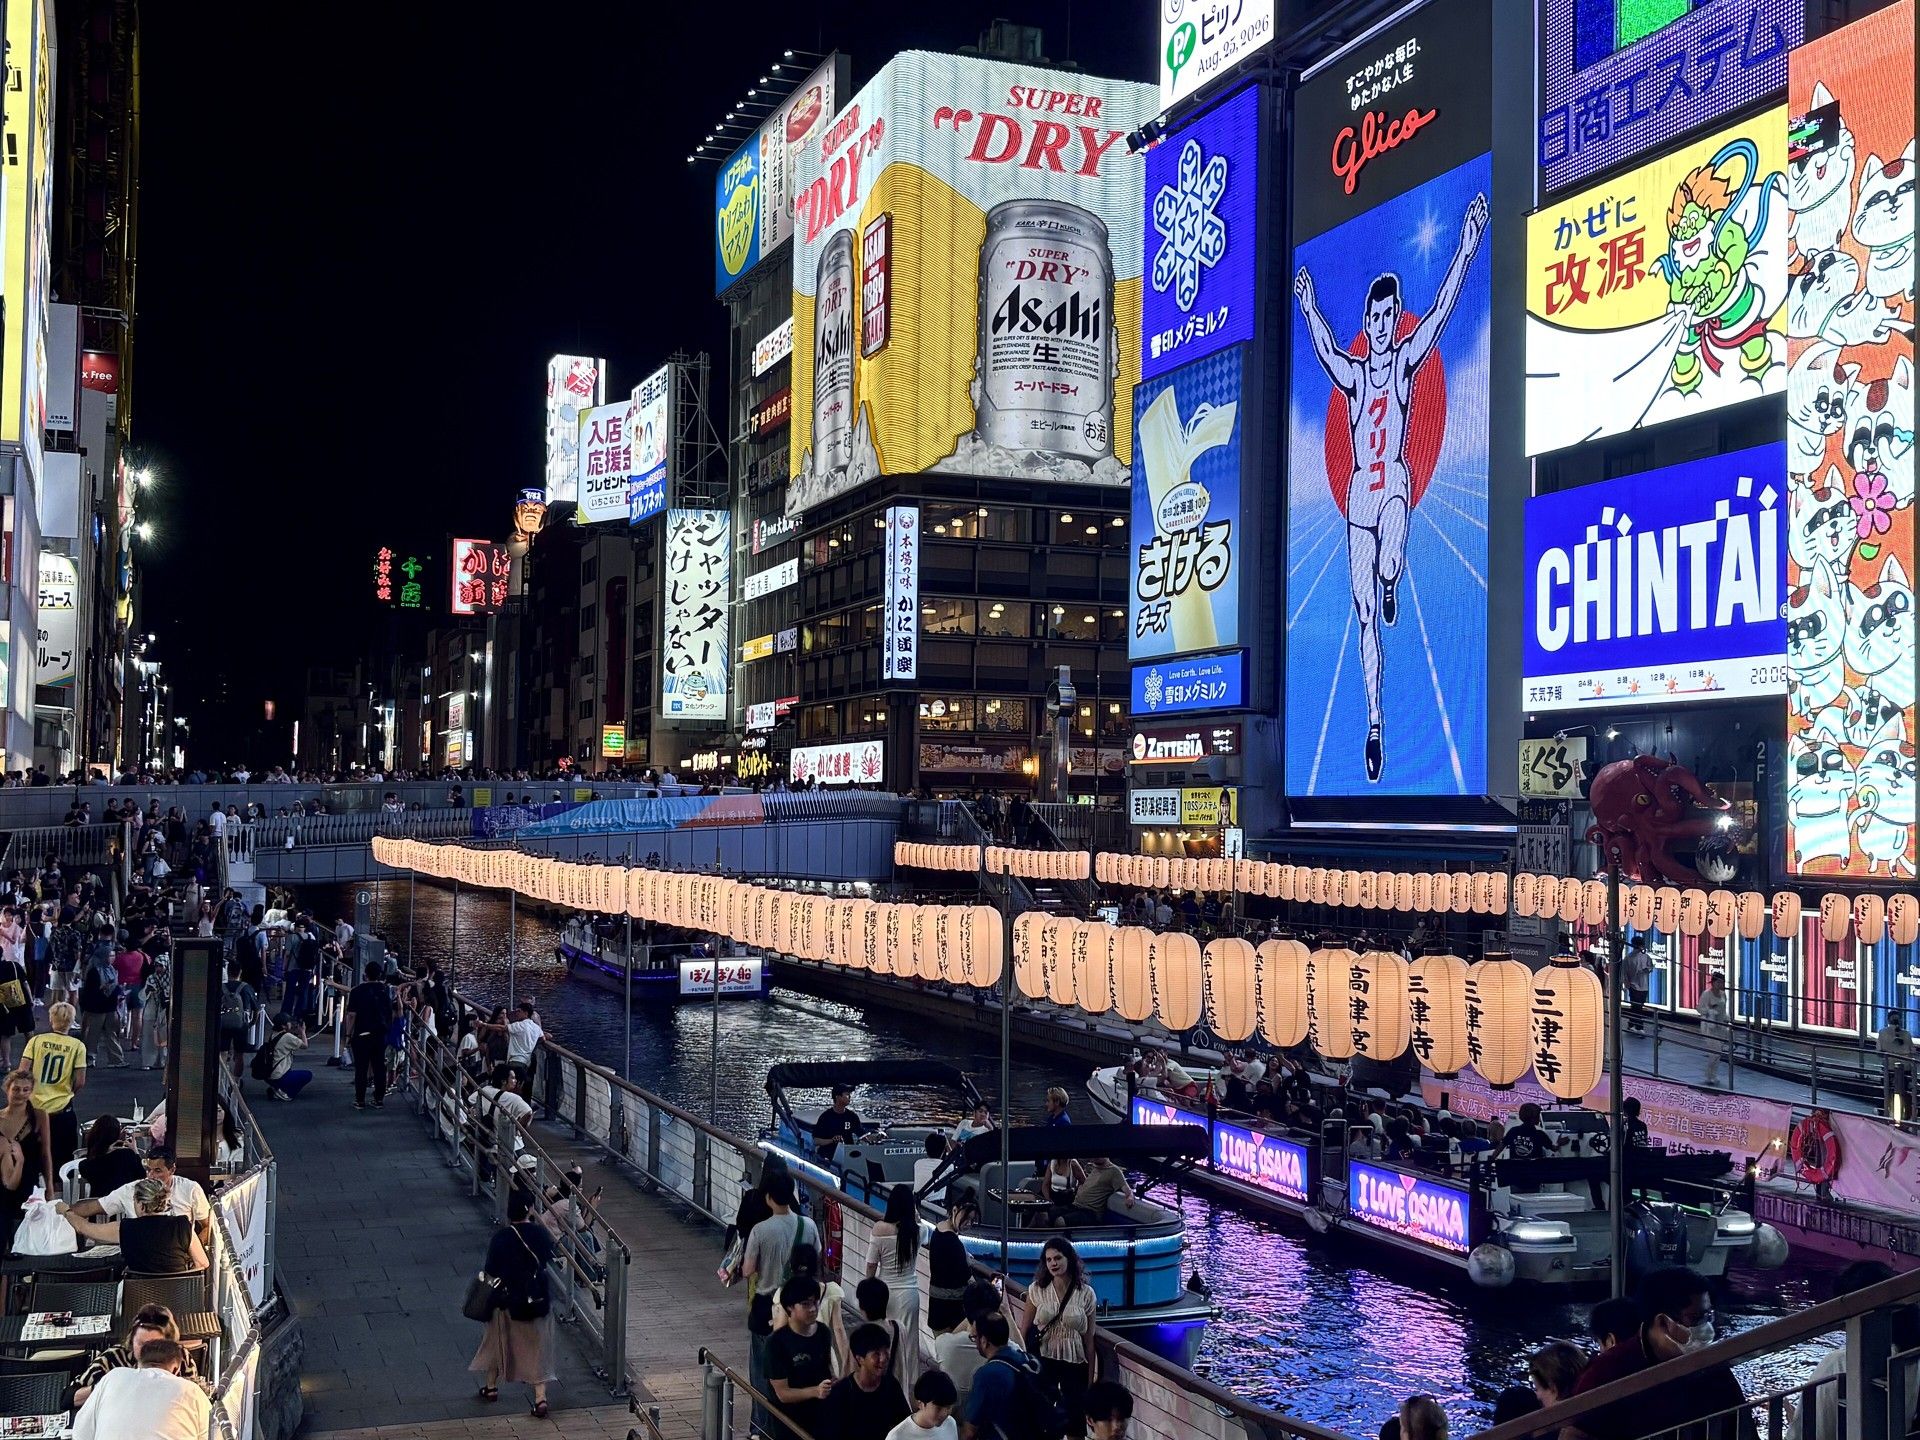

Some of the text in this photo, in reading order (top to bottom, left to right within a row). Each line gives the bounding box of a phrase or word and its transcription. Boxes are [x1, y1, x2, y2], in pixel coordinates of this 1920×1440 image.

[1197, 51, 1222, 77] Aug.
[1239, 14, 1269, 51] 2026
[1345, 37, 1421, 94] すこやかな毎日、
[1006, 84, 1103, 119] SUPER
[1350, 62, 1414, 111] ゆたかな人生
[1331, 108, 1437, 195] Glico
[864, 225, 886, 268] ASAHI
[1553, 194, 1637, 253] かぜに
[1028, 248, 1070, 262] SUPER
[1543, 224, 1647, 316] 改源
[863, 272, 885, 315] 1889
[991, 283, 1100, 344] Asahi
[863, 310, 885, 354] OSAKA
[1032, 343, 1060, 365] 生
[1149, 305, 1229, 360] 雪印メグミルク
[91, 370, 113, 380] Free
[1013, 381, 1080, 397] スーパードライ
[587, 416, 623, 448] 入店
[1368, 389, 1390, 493] グリコ
[1136, 519, 1233, 602] さける
[1536, 476, 1779, 653] CHINTAI
[666, 516, 698, 676] だけじゃない
[896, 534, 915, 674] 本場の味 かに道楽
[1135, 600, 1172, 639] チーズ
[1164, 681, 1228, 706] 雪印メグミルク
[1169, 670, 1181, 680] Love
[1198, 667, 1211, 676] Love
[1529, 685, 1563, 703] 天気予報
[816, 752, 852, 778] かに道楽
[1146, 737, 1204, 758] ZETTERIA
[1770, 953, 1787, 963] Street
[1837, 958, 1855, 970] Street
[1349, 965, 1370, 1053] 高津宮
[1408, 975, 1435, 1061] 三津寺
[1465, 980, 1485, 1065] 三津寺
[1532, 988, 1564, 1084] 三津寺
[41, 1051, 65, 1085] 10
[1228, 1134, 1257, 1176] LOVE
[1258, 1147, 1302, 1190] OSAKA
[1369, 1179, 1406, 1224] LOVE
[1407, 1190, 1464, 1242] OSAKA
